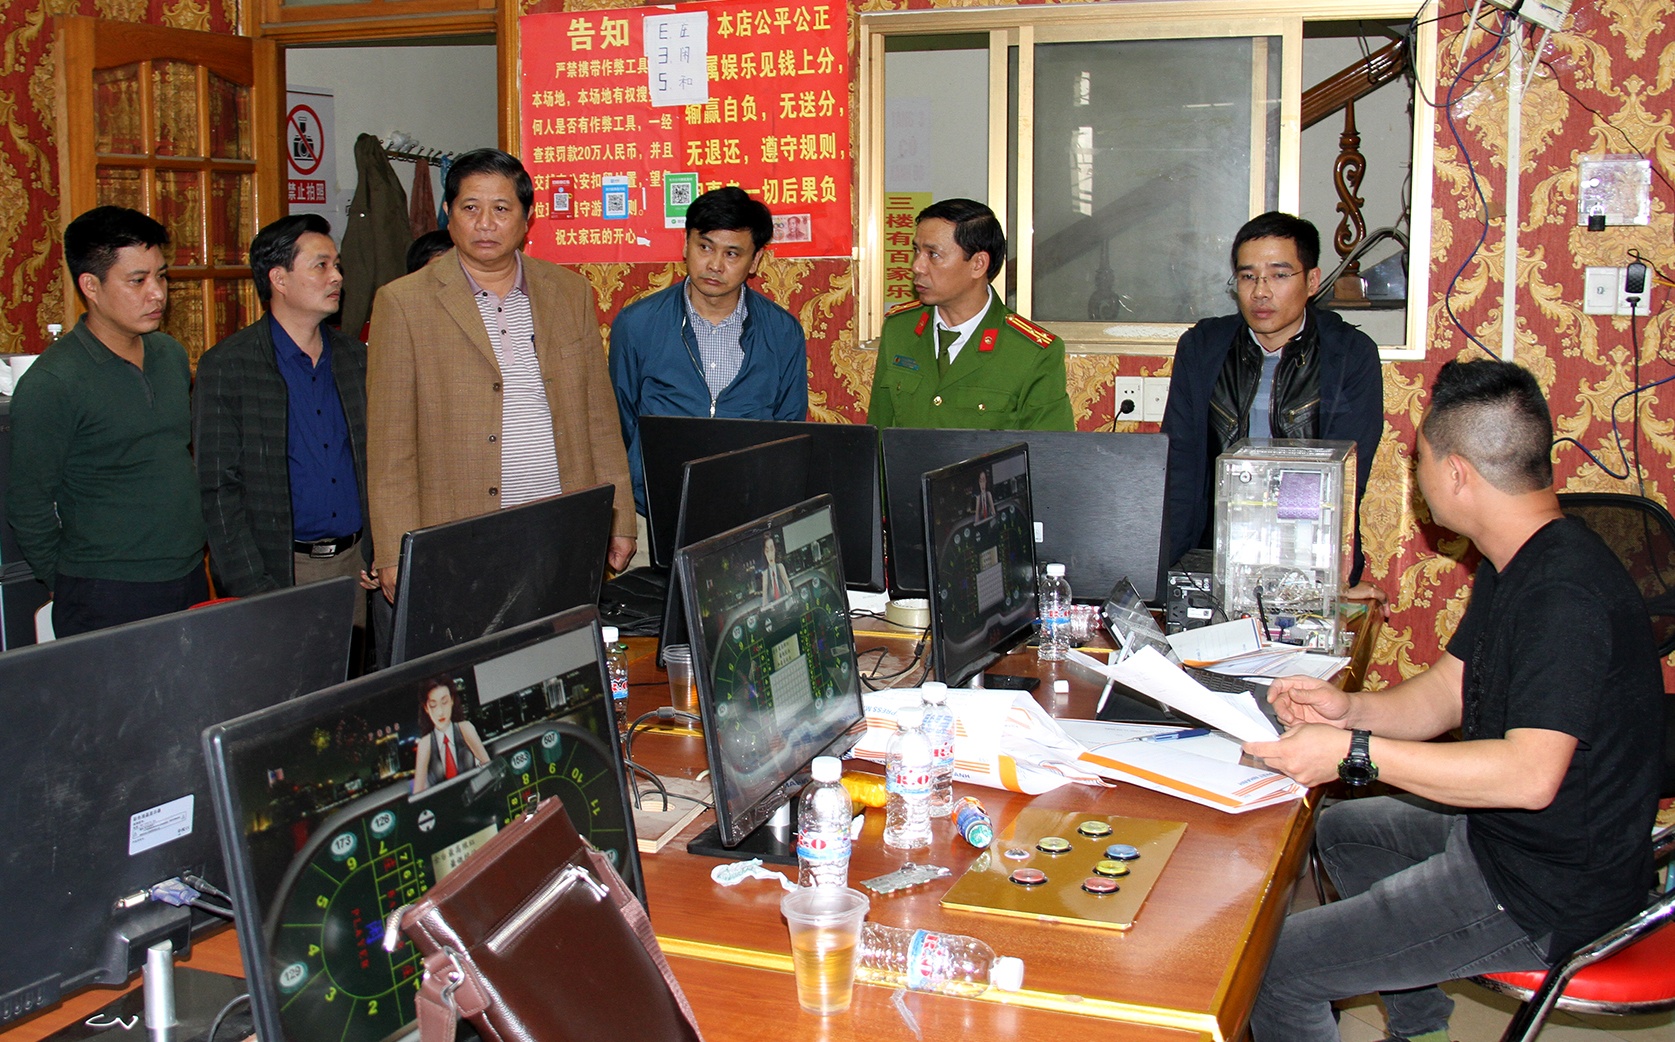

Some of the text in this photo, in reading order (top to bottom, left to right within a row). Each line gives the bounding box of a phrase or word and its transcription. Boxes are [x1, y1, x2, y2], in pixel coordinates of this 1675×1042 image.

[716, 5, 832, 39] 本店公平公正
[567, 16, 630, 51] 告知
[532, 86, 653, 108] 本场地，本场地有权搜
[532, 113, 673, 136] 何人是否有作弊工具，一经
[533, 142, 674, 164] 查获罚款20万人民币，并且
[686, 132, 846, 166] 无退还，遵守规则，
[288, 182, 325, 201] 禁止拍照
[555, 228, 637, 246] 祝大家玩的开心
[886, 196, 915, 299] 三楼有百家乐
[324, 986, 337, 1003] 3
[367, 1000, 379, 1016] 2
